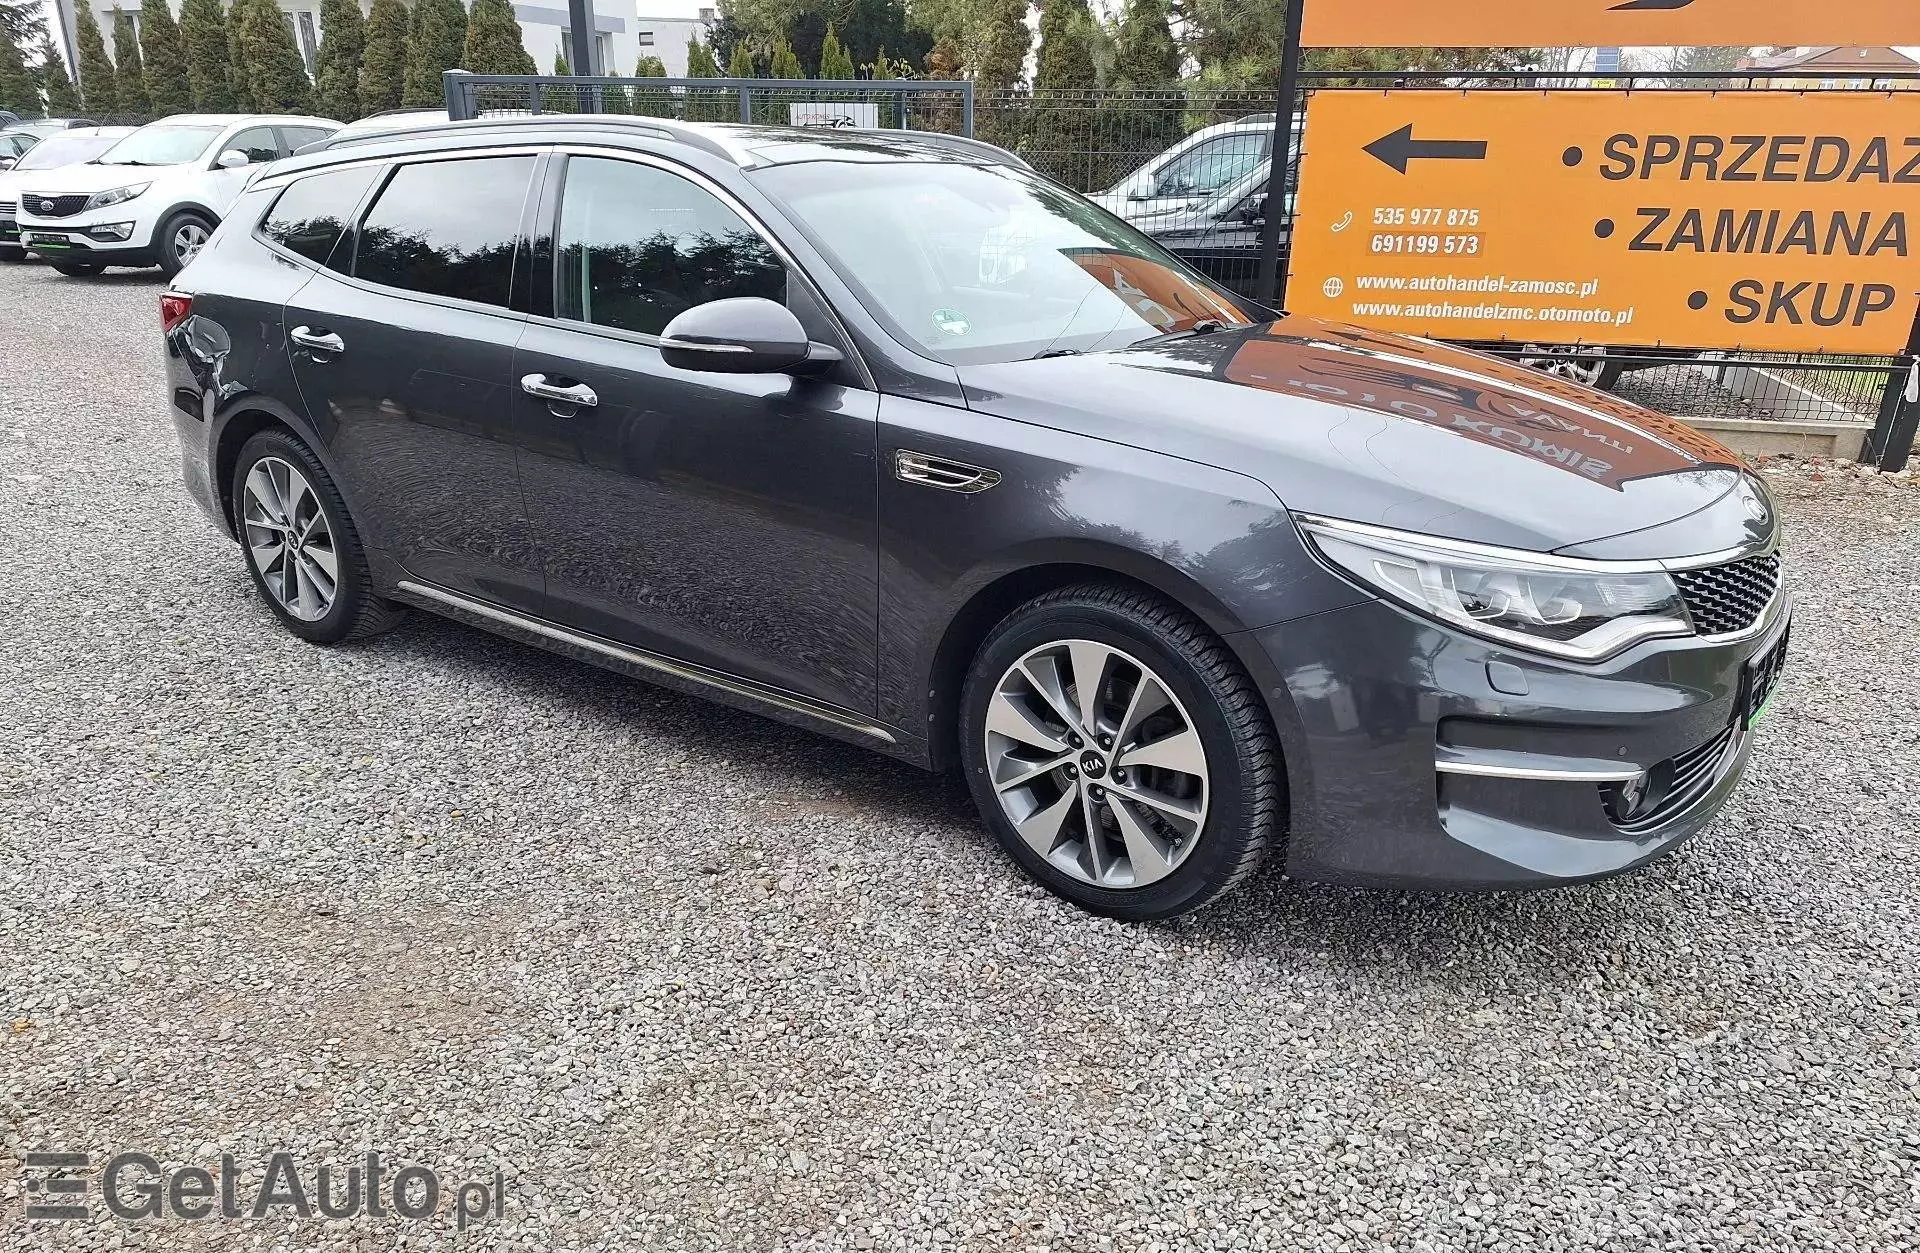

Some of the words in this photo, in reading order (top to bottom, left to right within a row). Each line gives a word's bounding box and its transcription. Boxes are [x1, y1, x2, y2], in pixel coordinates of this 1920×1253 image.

[1373, 207, 1405, 225] 535
[1410, 208, 1441, 226] 977
[1446, 208, 1480, 227] 875
[1444, 235, 1479, 254] 573
[1628, 207, 1907, 257] ZAMIANA
[1356, 274, 1599, 299] www.autohandel-zamosc.pl
[1352, 301, 1634, 327] www.autohandelzmc.otomoto.pl
[1724, 280, 1896, 327] SKUP
[1081, 758, 1104, 773] KIA
